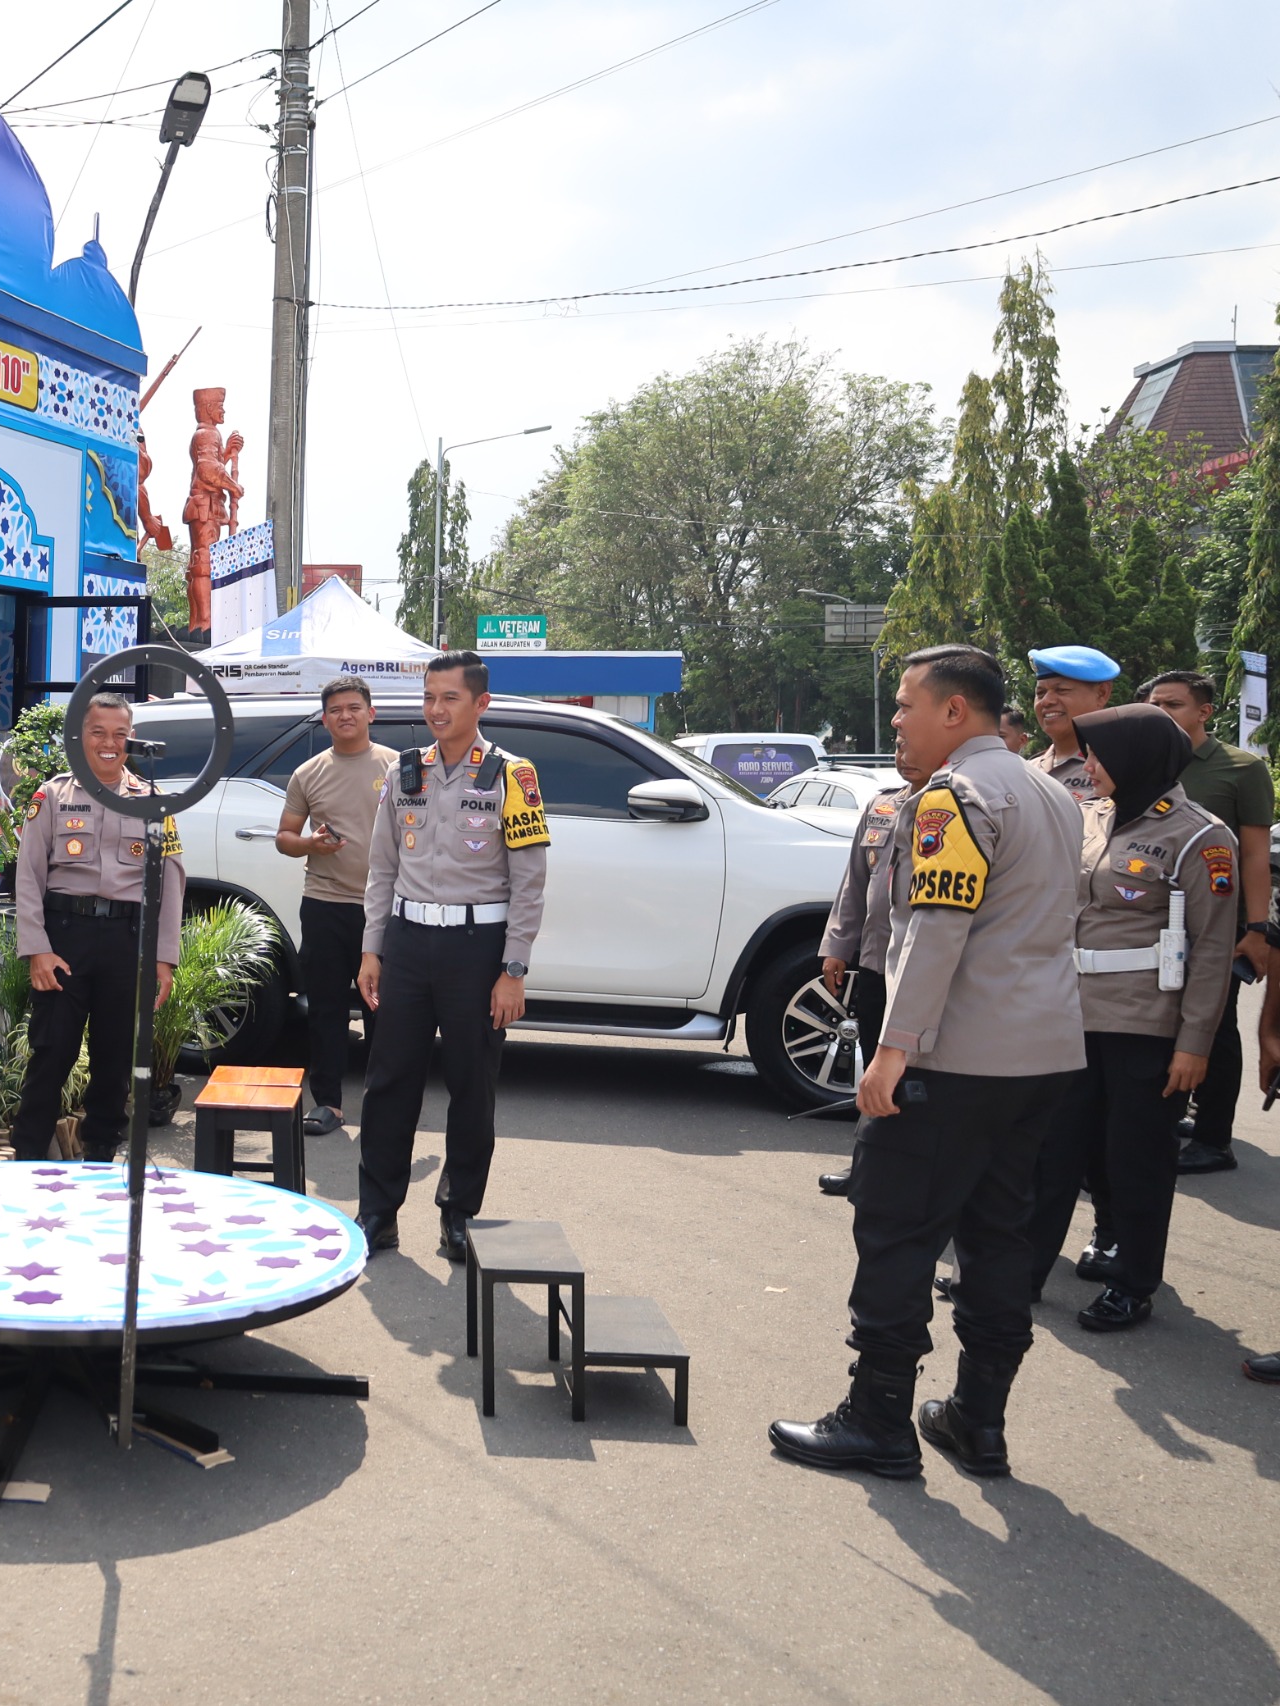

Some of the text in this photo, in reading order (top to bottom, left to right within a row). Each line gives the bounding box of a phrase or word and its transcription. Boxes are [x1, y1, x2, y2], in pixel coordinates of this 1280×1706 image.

[483, 620, 541, 634] JL. VETERAN
[480, 640, 498, 648] JALAN
[738, 761, 794, 772] ROAD SERVICE
[396, 798, 428, 807] DOOHAN
[460, 801, 496, 812] POLRI
[1127, 842, 1167, 859] POLRI
